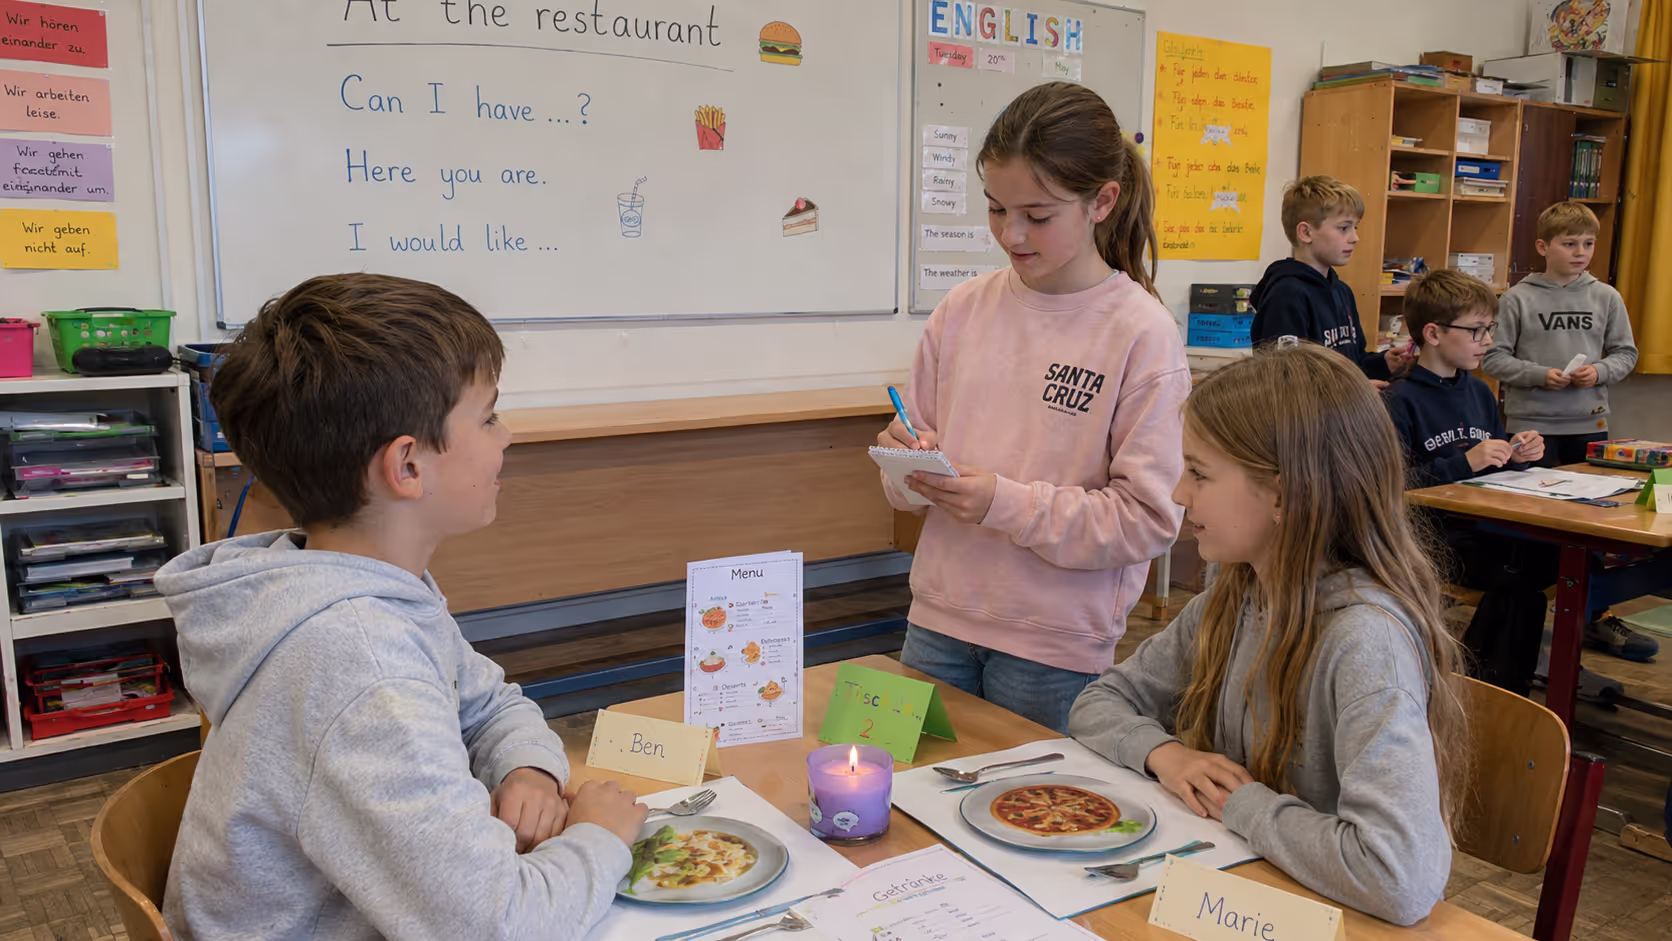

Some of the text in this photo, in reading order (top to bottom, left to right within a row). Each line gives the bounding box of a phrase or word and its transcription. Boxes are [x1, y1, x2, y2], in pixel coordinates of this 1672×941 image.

[6, 11, 79, 32] Wir hören
[440, 0, 509, 27] the
[536, 0, 722, 46] restaurant
[932, 0, 1081, 51] ENGLISH
[1, 36, 85, 54] einander zu.
[4, 84, 90, 103] Wir arbeiten
[341, 74, 404, 113] Can
[428, 82, 447, 114] I
[476, 85, 535, 122] have
[26, 105, 61, 120] leise.
[16, 145, 84, 164] Wir gehen
[346, 148, 547, 200] Here you are.
[22, 222, 90, 239] Wir geben
[348, 222, 367, 251] I
[390, 224, 464, 252] would
[486, 224, 528, 251] like
[924, 230, 974, 239] The season is
[24, 241, 91, 257] nicht auf.
[924, 268, 978, 278] The weather is
[1538, 311, 1593, 331] VANS
[1044, 363, 1105, 394] SANTA
[1042, 383, 1094, 413] CRUZ
[731, 568, 764, 580] Menu
[860, 718, 874, 739] 2
[630, 732, 665, 758] Ben
[1197, 891, 1275, 941] Marie
